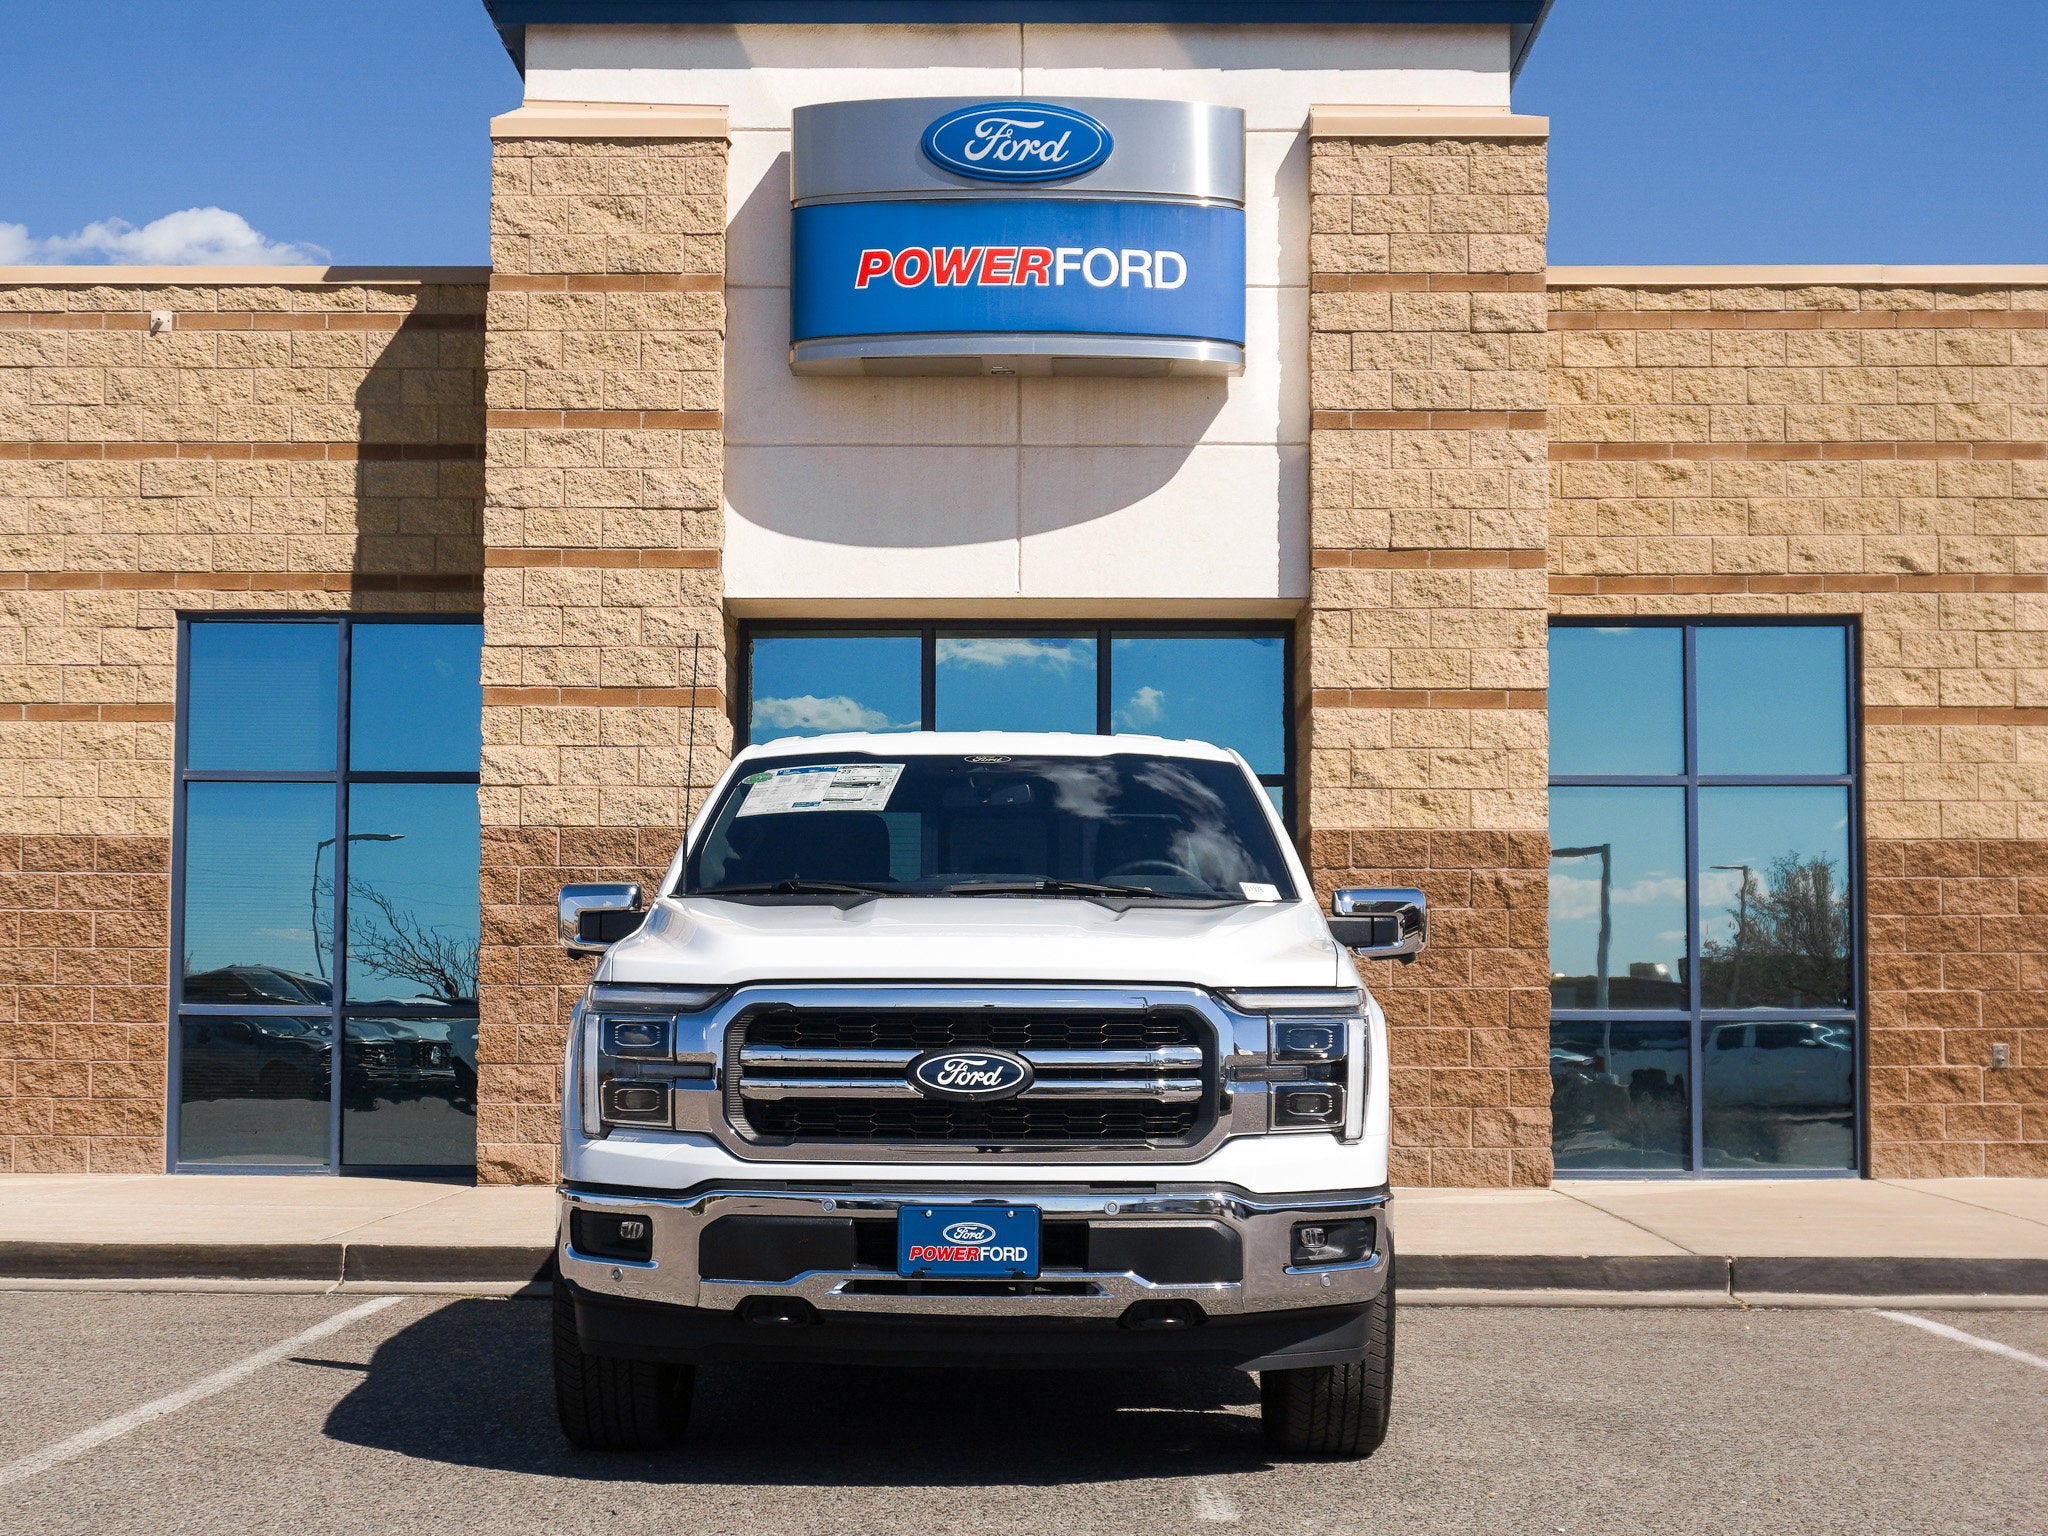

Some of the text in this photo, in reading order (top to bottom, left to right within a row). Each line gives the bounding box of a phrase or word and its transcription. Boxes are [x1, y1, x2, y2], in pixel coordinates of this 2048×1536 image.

[963, 117, 1071, 162] Ford
[855, 246, 1187, 290] POWERFORD
[937, 1058, 1004, 1086] Ford
[953, 1226, 985, 1240] Ford
